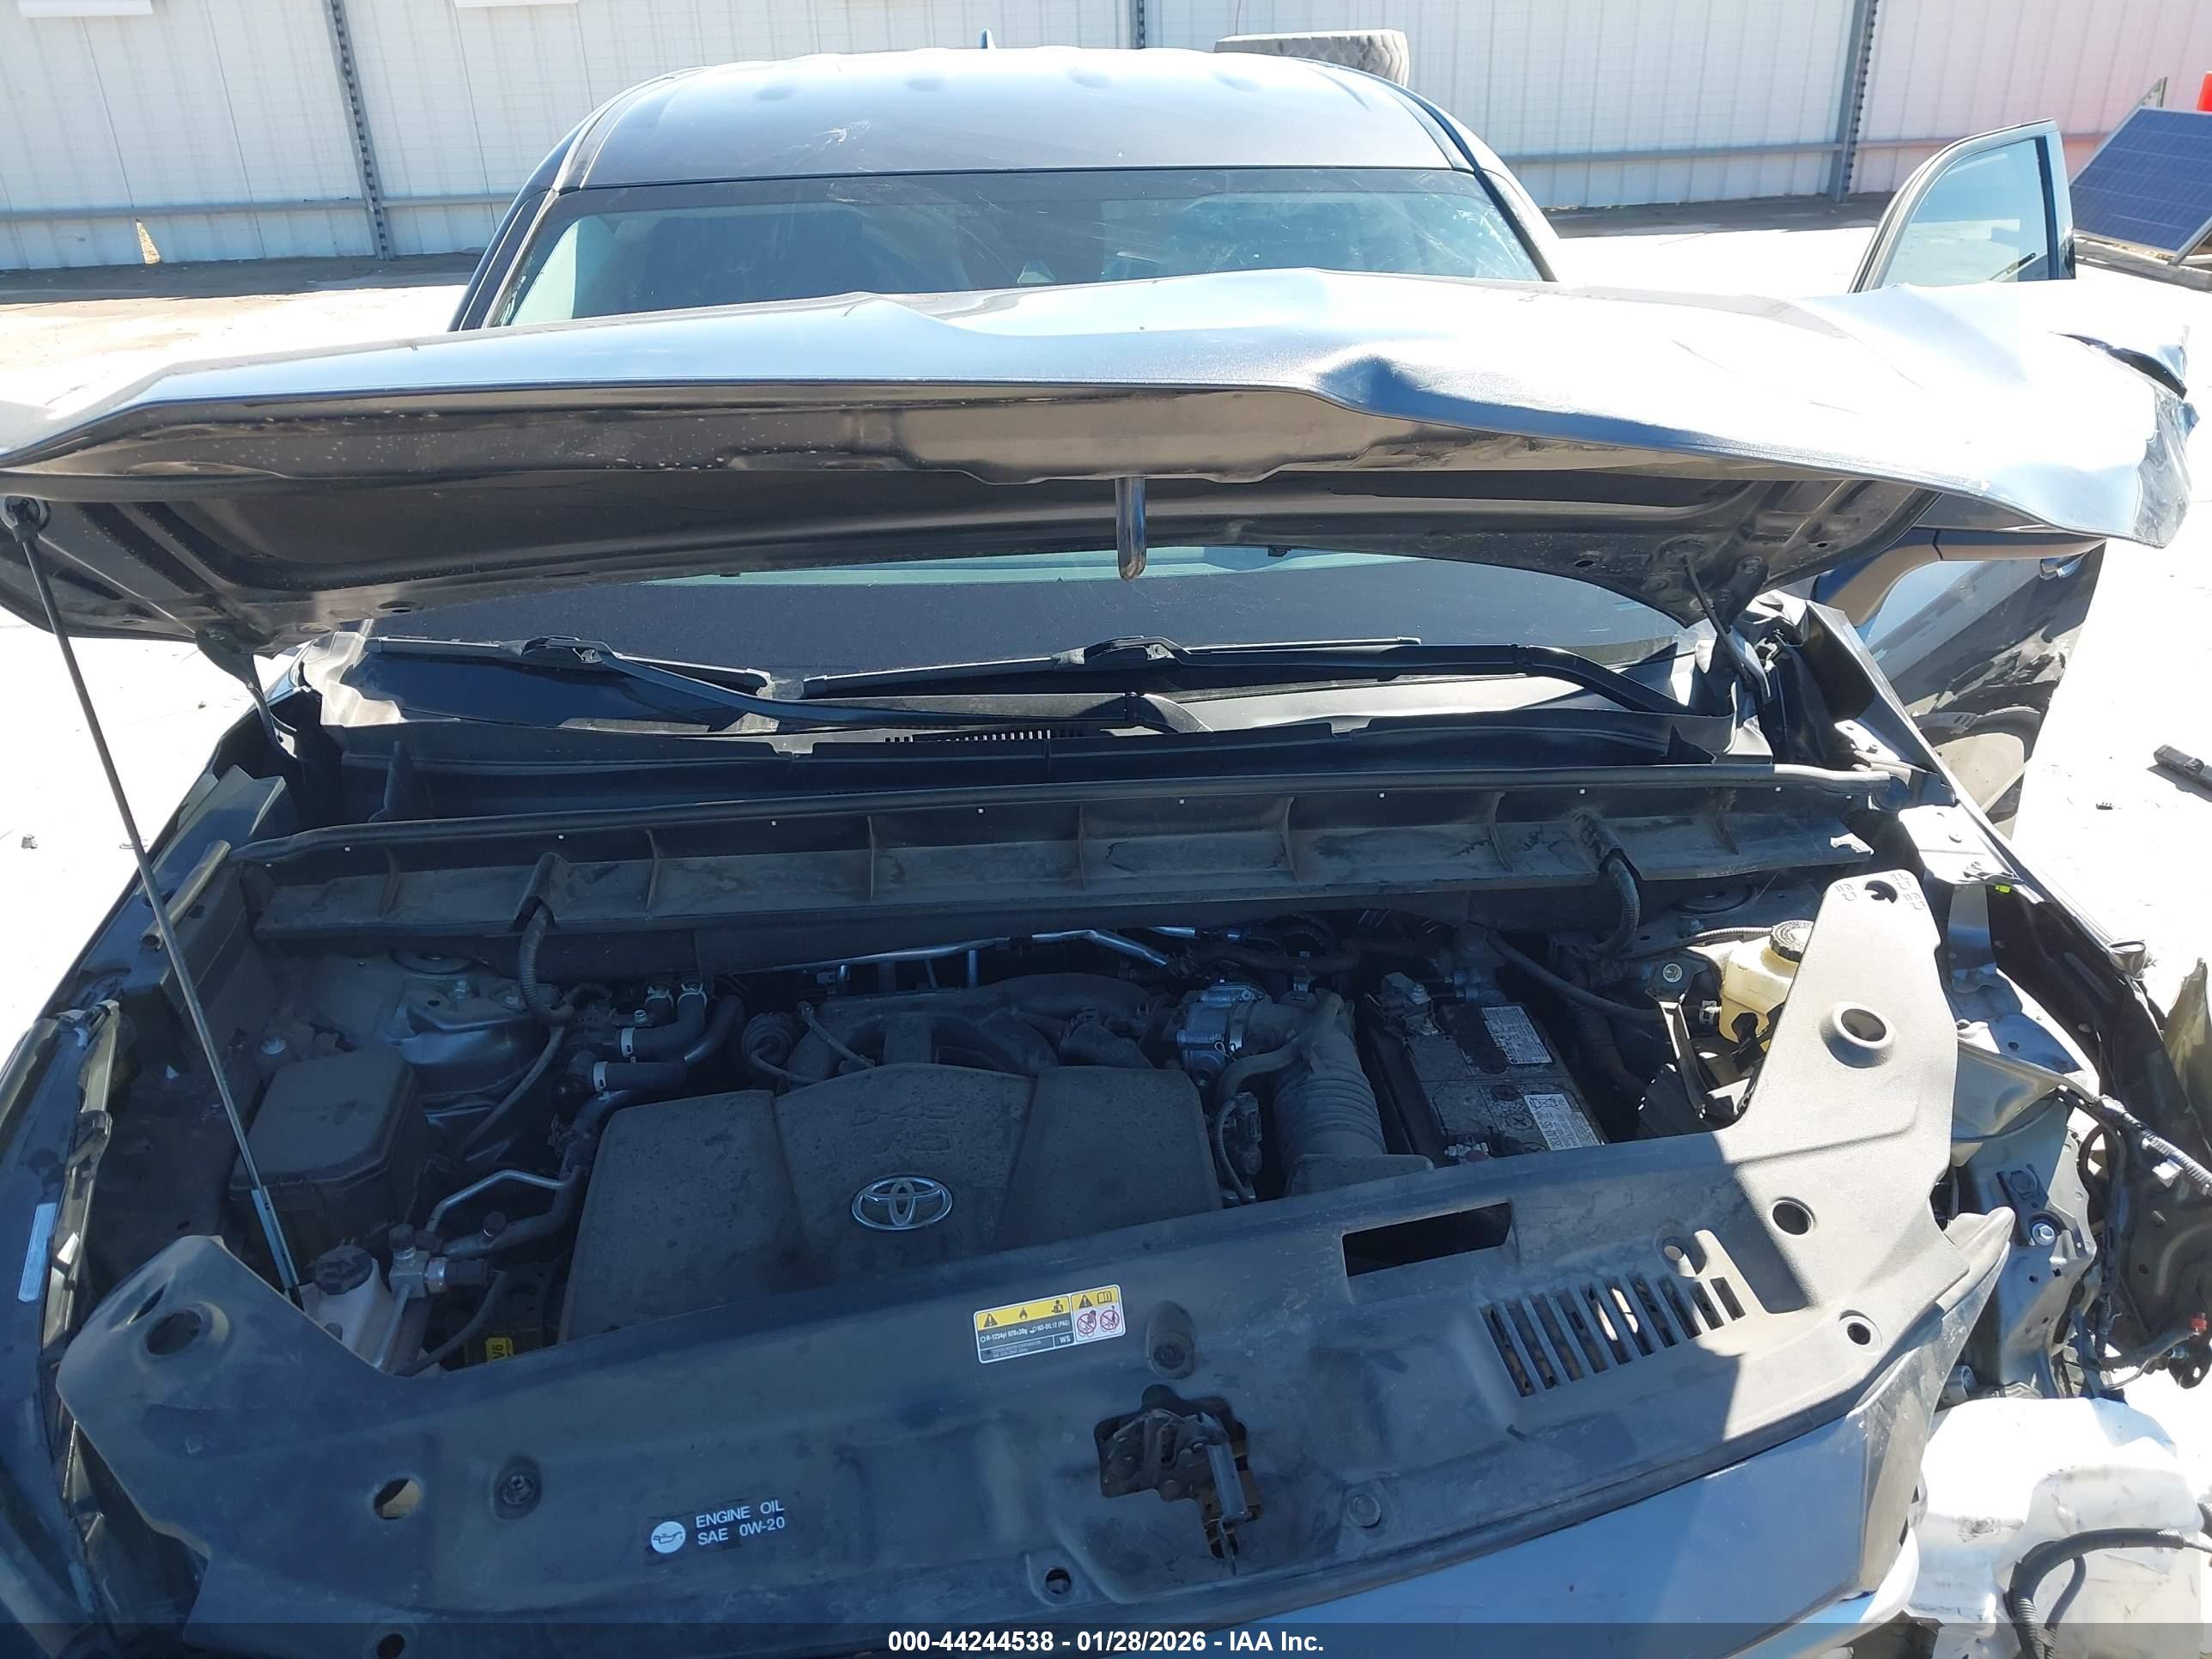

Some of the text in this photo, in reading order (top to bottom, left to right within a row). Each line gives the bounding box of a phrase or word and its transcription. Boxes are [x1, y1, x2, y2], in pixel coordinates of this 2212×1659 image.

[1059, 1335, 1071, 1344] WS
[696, 1499, 785, 1528] ENGINE OIL
[697, 1516, 786, 1546] SAE 0W-20
